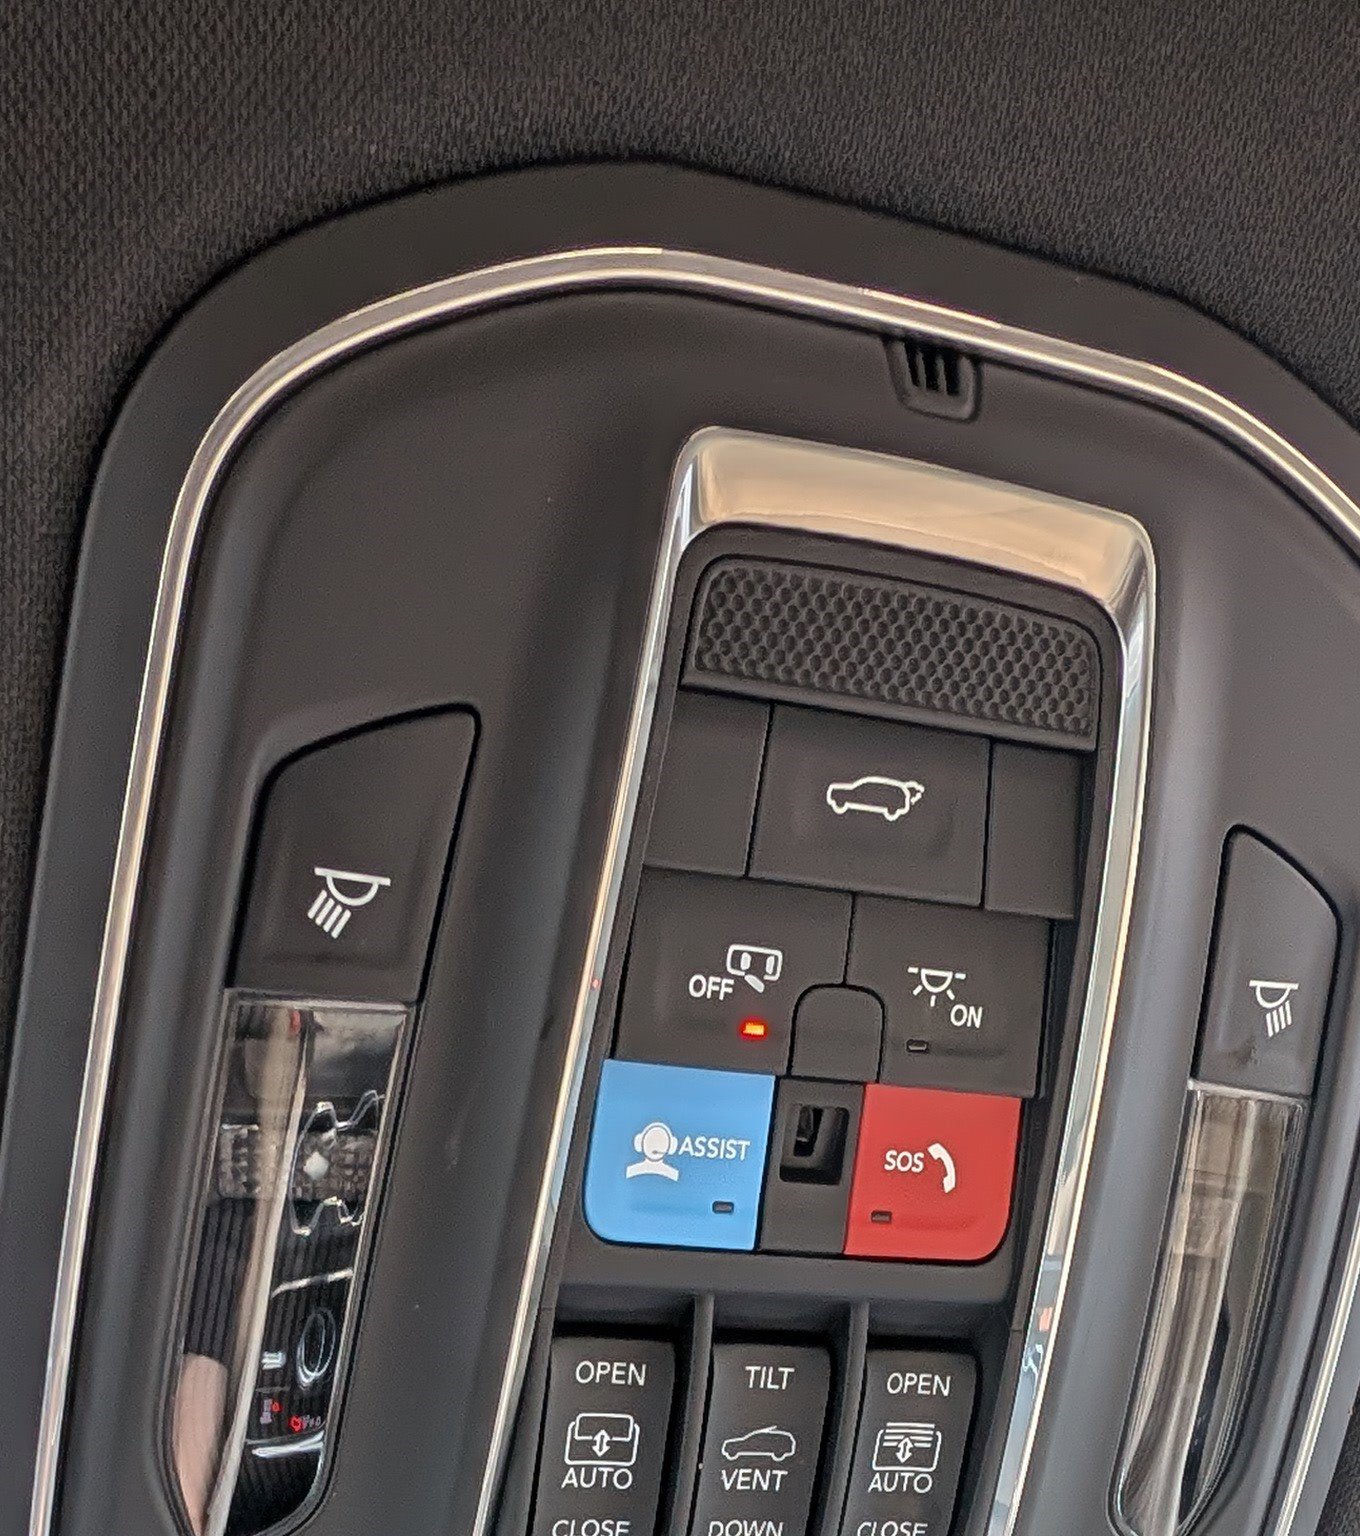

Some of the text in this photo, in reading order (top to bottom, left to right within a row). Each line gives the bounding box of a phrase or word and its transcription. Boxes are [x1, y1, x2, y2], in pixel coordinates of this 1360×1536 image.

[689, 976, 734, 1000] OFF
[950, 1005, 982, 1028] ON
[679, 1138, 750, 1161] ASSIST
[885, 1150, 924, 1172] SOS
[576, 1361, 646, 1387] OPEN
[746, 1366, 794, 1389] TILT
[887, 1373, 950, 1396] OPEN
[562, 1468, 632, 1490] AUTO
[722, 1470, 787, 1492] VENT
[869, 1473, 932, 1493] AUTO
